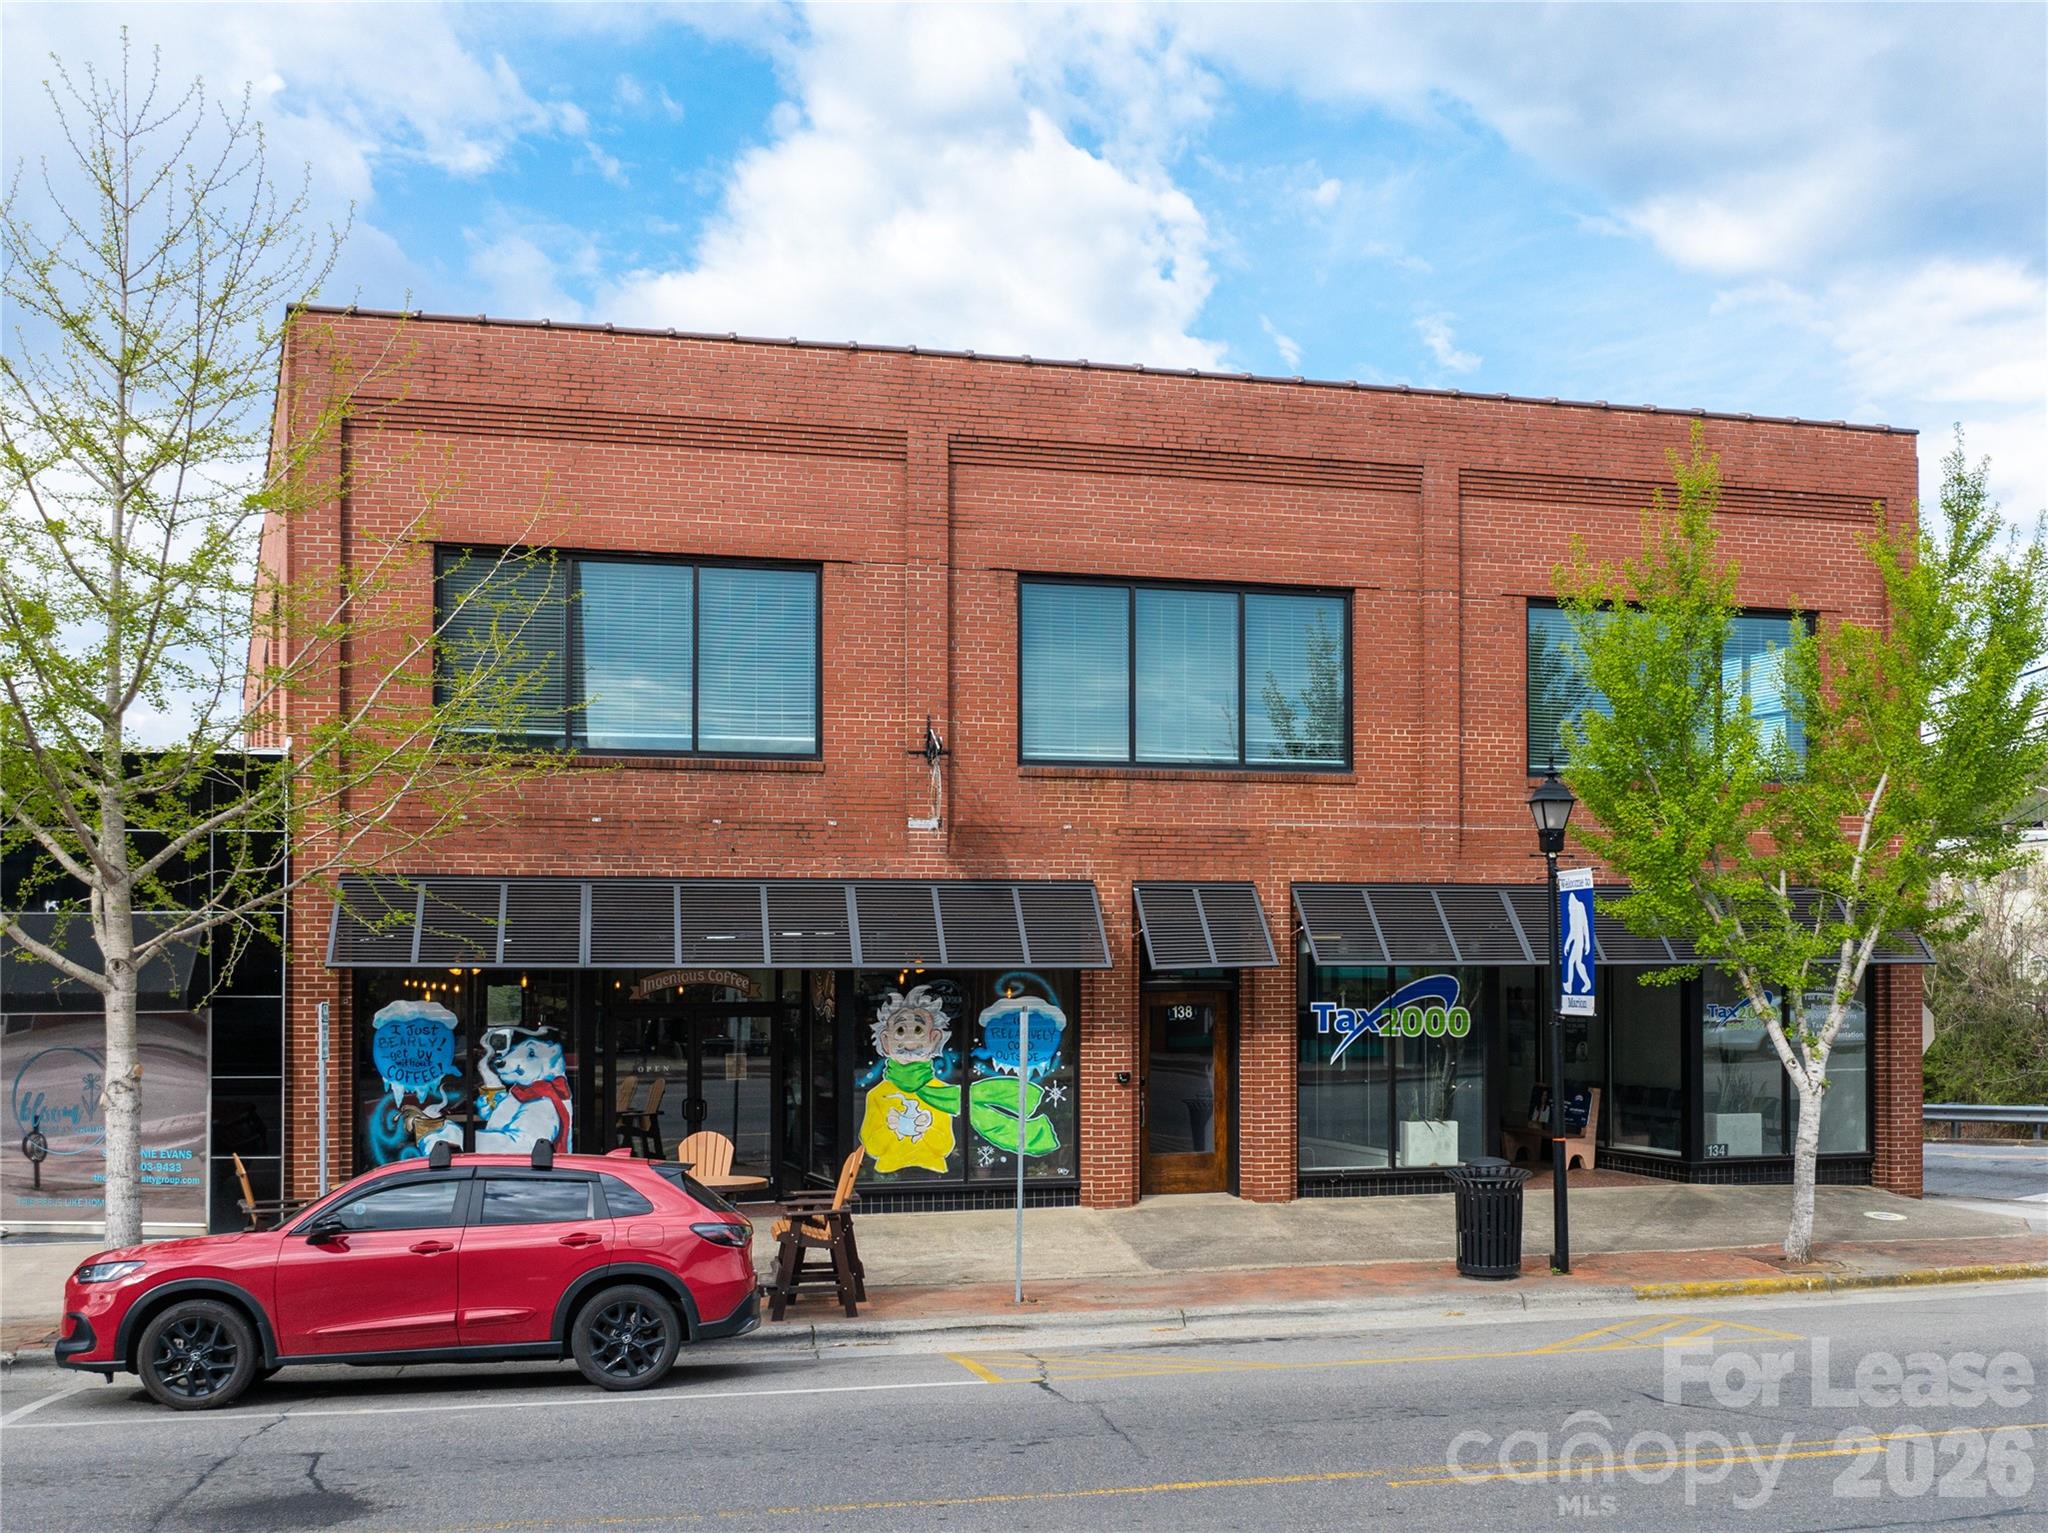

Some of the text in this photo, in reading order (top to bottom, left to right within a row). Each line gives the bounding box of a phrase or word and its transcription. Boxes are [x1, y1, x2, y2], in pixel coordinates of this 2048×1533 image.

[643, 969, 750, 992] Ingenious Coffee
[1172, 1006, 1193, 1018] 138
[391, 1024, 401, 1036] I
[991, 1026, 1056, 1042] RELAIVELY
[1310, 1001, 1471, 1065] Tax2000
[1007, 1040, 1034, 1050] COD
[417, 1048, 433, 1061] by
[995, 1050, 1039, 1062] OUTSDE
[395, 1058, 432, 1067] without
[637, 1064, 671, 1073] OPEN
[387, 1062, 444, 1084] COFFEE!
[160, 1150, 193, 1159] EVANS
[1708, 1144, 1725, 1157] 134
